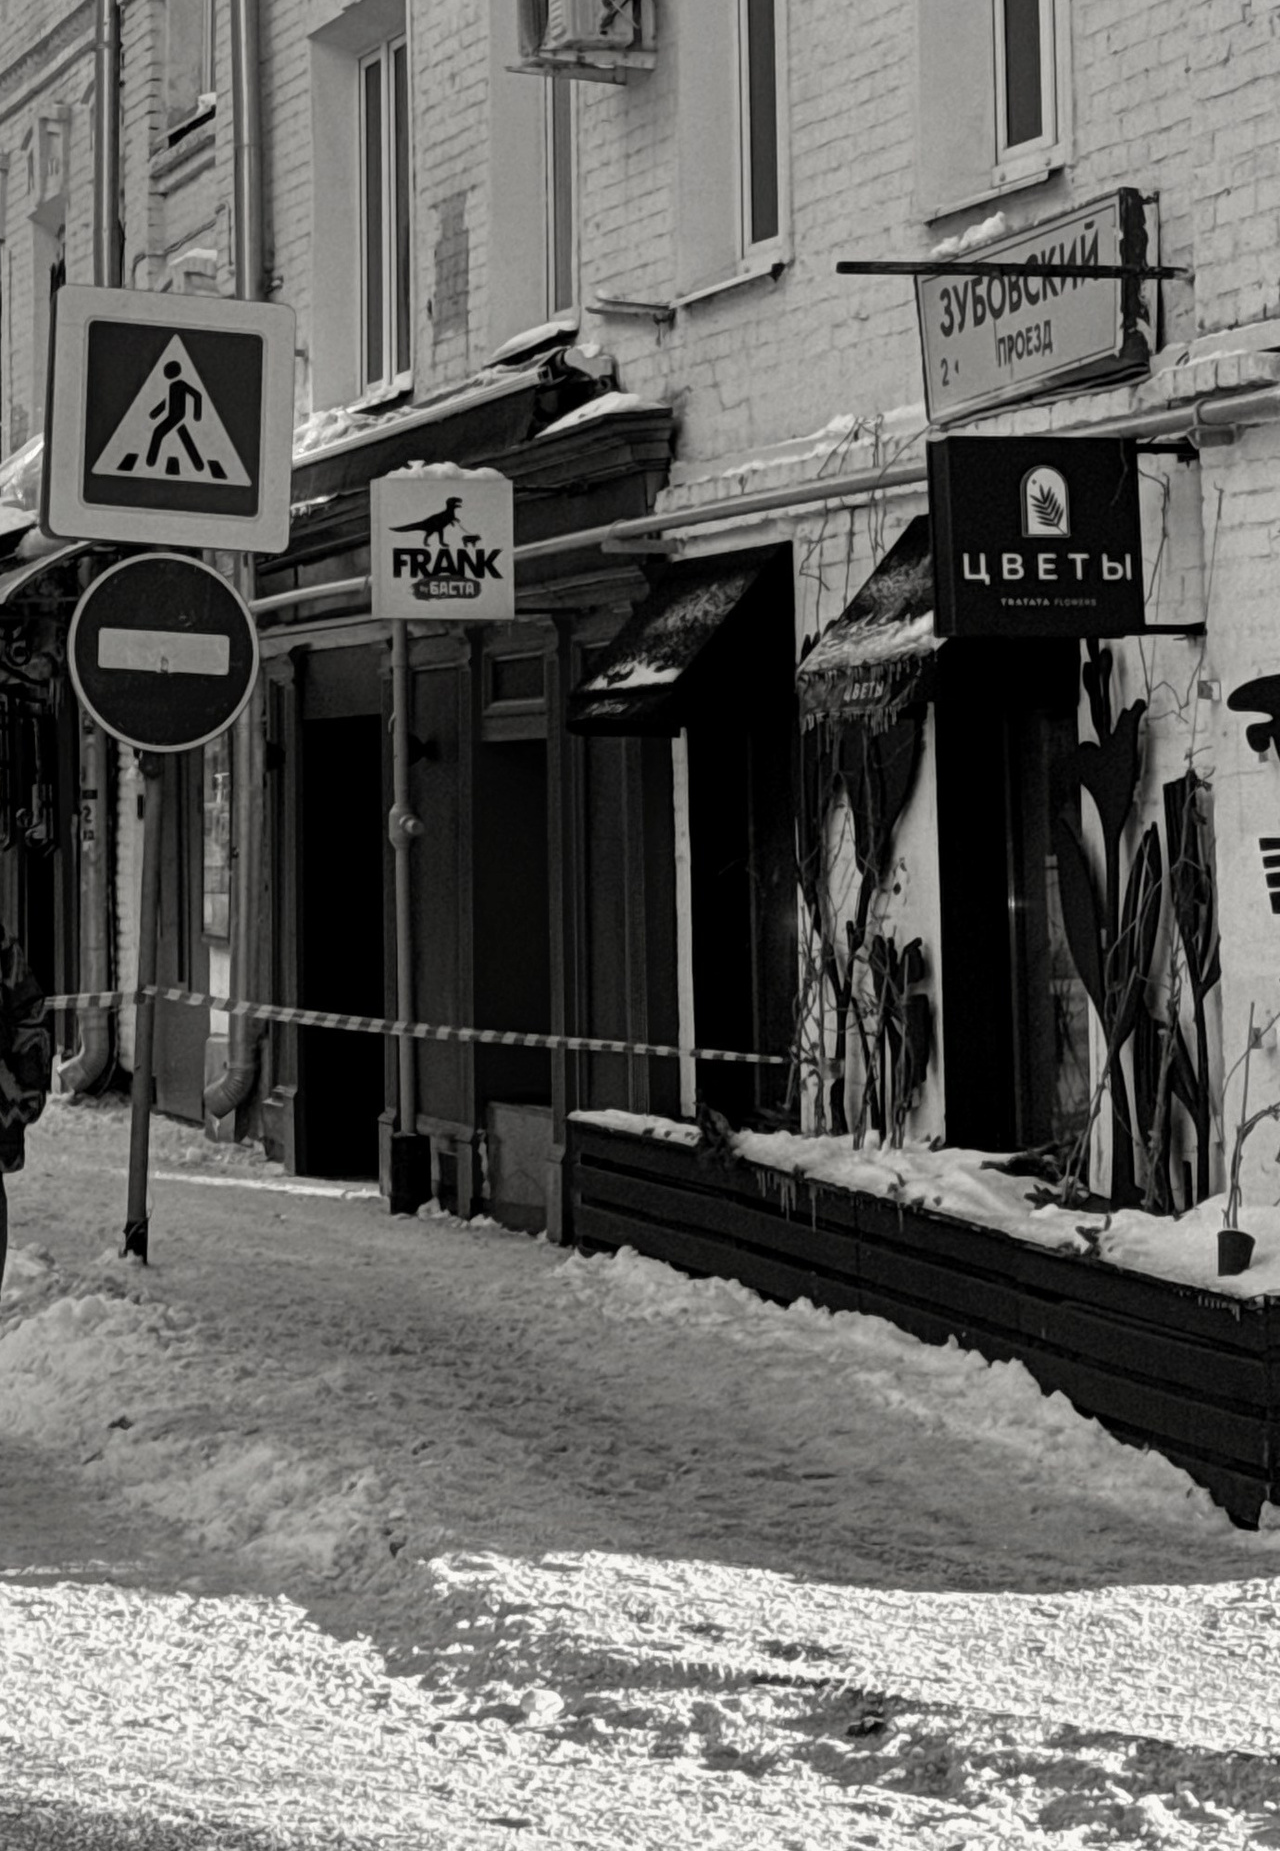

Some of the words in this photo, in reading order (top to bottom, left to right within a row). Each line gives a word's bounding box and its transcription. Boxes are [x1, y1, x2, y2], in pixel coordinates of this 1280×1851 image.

[940, 220, 1099, 337] ЗУБОВСКИЙ
[997, 319, 1053, 368] ПРОЕЗД
[393, 548, 503, 579] FRANK
[963, 553, 1132, 585] ЦВЕТЫ
[429, 581, 475, 596] БАСТА
